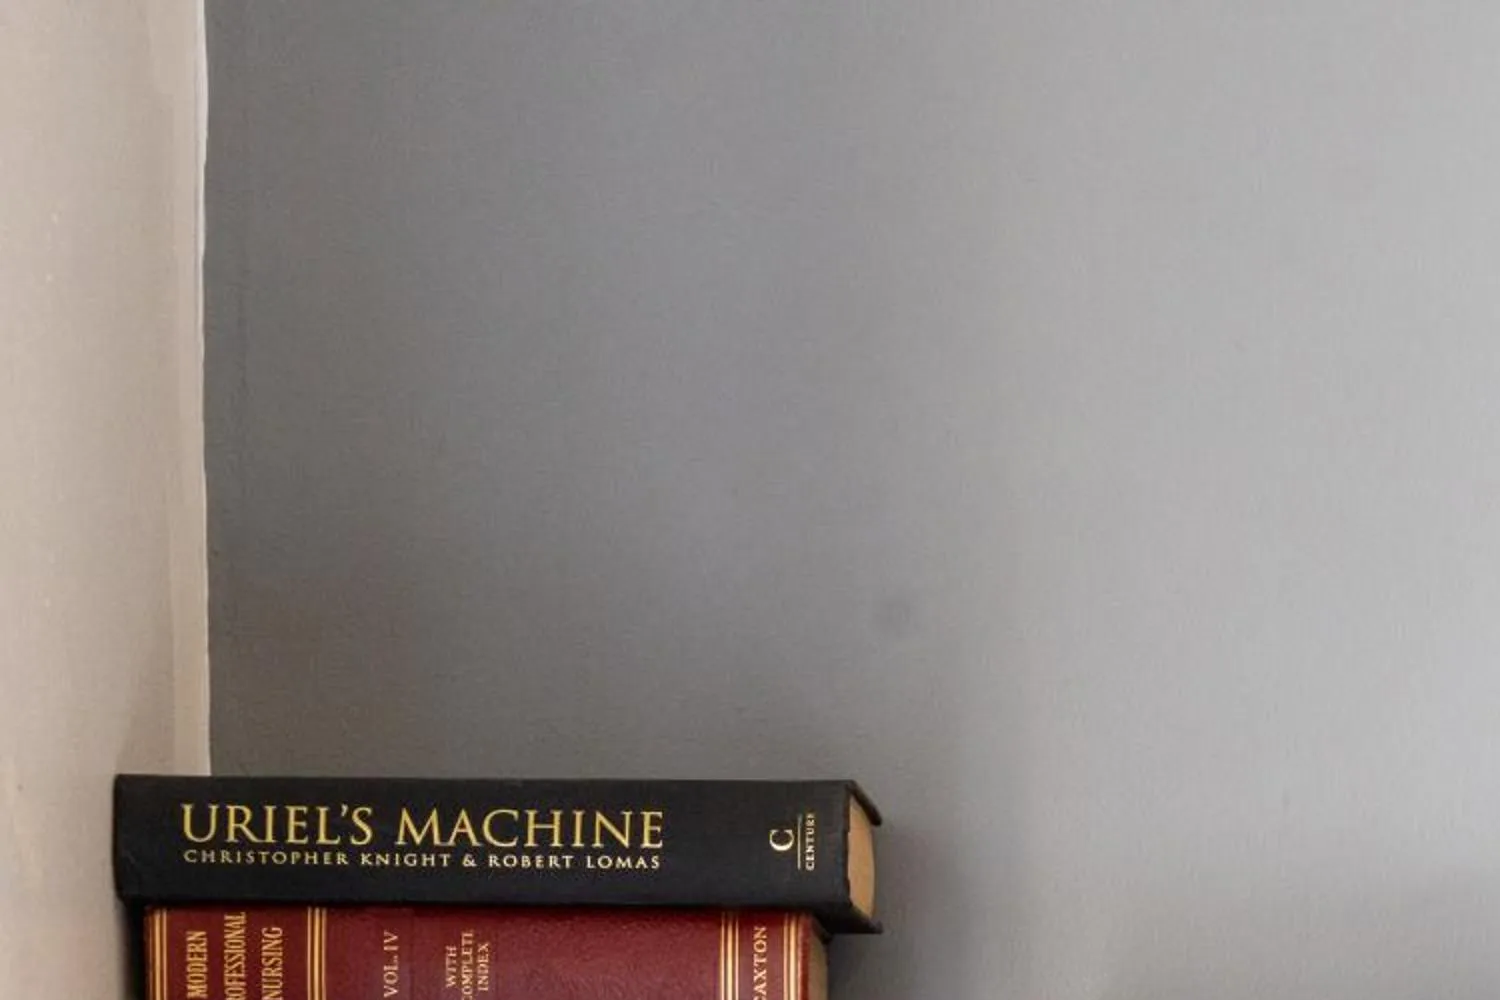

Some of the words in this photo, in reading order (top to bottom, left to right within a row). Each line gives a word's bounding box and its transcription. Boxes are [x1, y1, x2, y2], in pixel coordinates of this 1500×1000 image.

[181, 804, 374, 845] URIEL'S
[395, 806, 664, 850] MACHINE
[184, 849, 350, 866] CHRISTOPHER
[361, 853, 450, 868] KNIGHT
[462, 854, 477, 868] &
[488, 854, 574, 869] ROBERT
[586, 854, 661, 869] LOMAS
[384, 929, 399, 952] IV
[186, 930, 208, 1000] MODERN
[445, 945, 457, 988] WITH
[477, 943, 490, 992] INDEX
